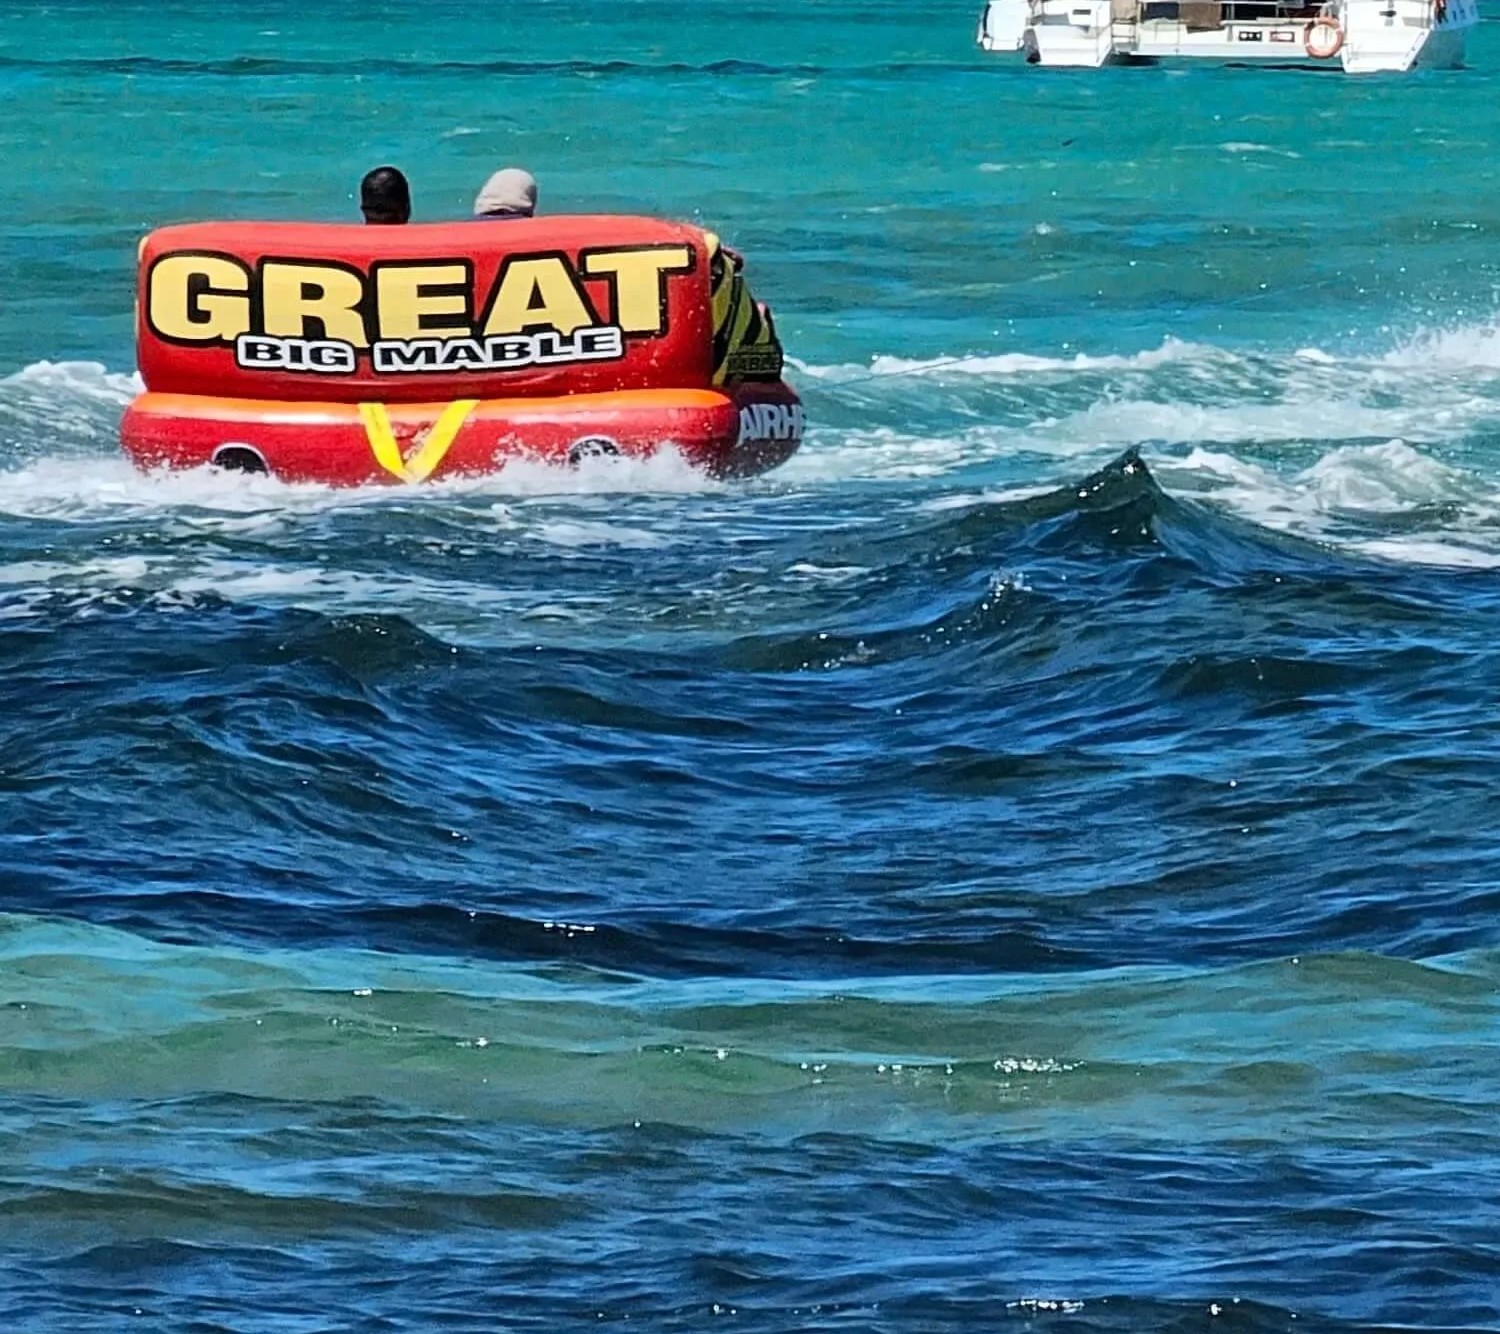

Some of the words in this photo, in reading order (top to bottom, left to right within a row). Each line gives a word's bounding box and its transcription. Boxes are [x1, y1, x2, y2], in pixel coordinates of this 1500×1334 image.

[148, 248, 690, 349] GREAT
[240, 338, 353, 370] BIG
[376, 327, 621, 369] MABLE
